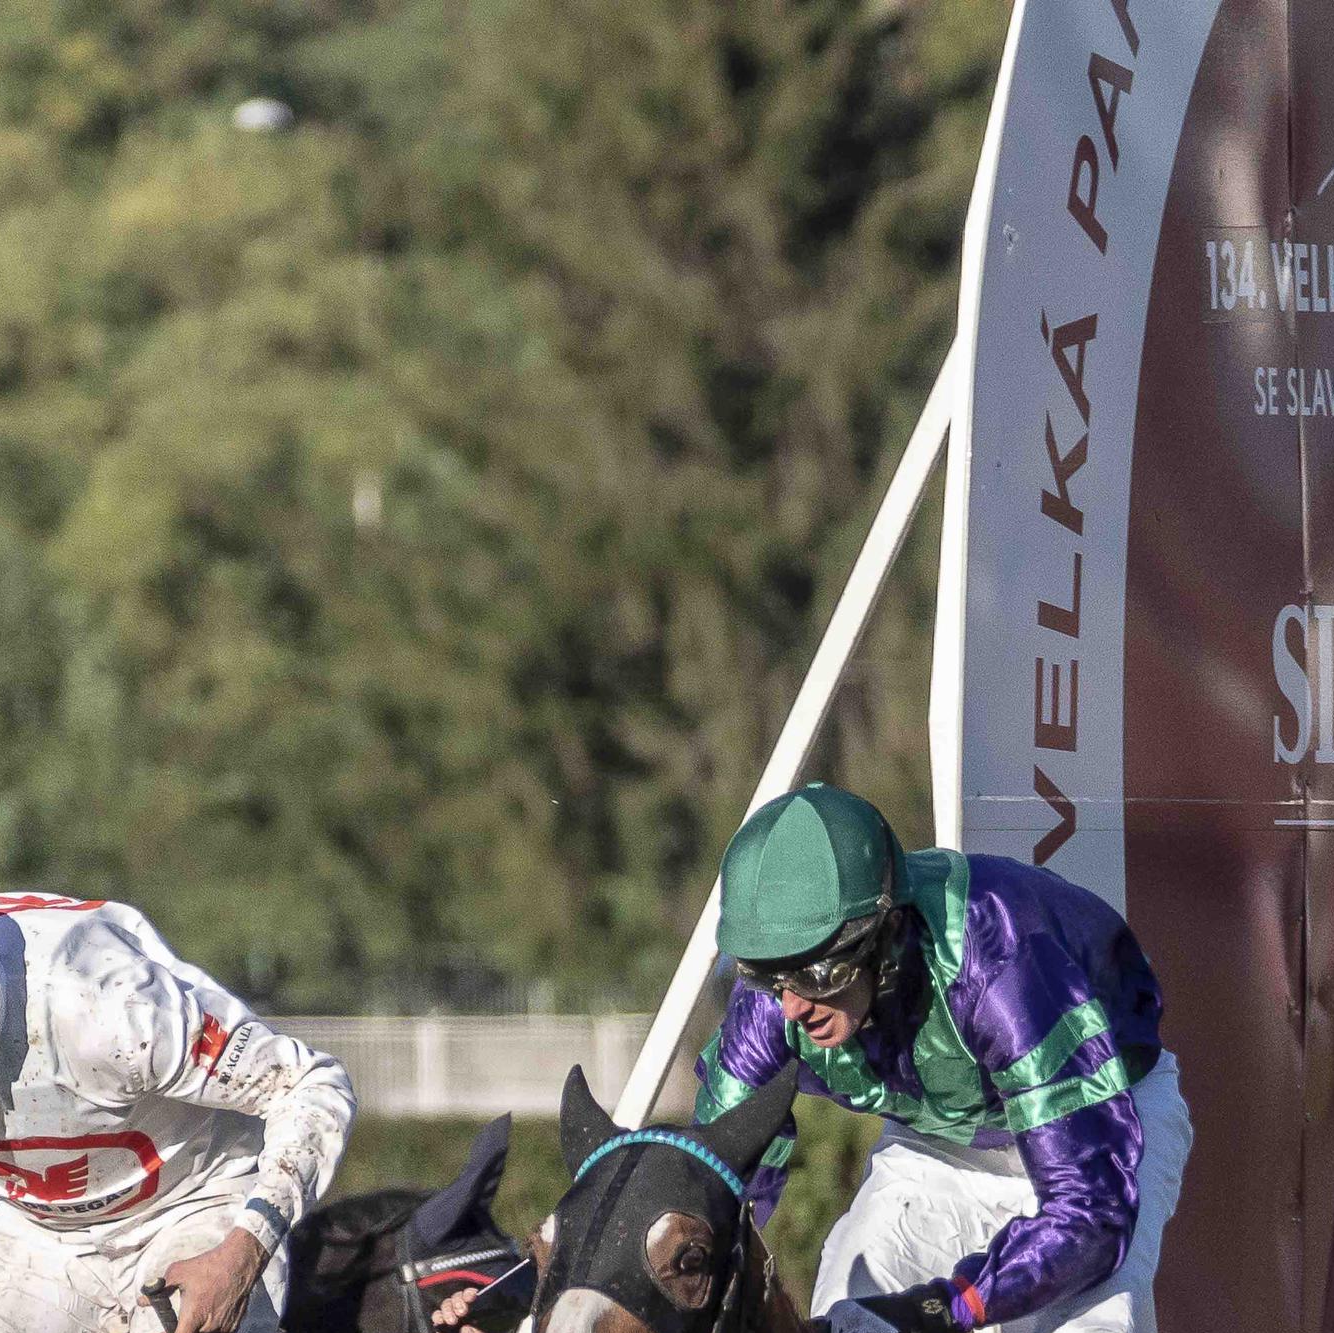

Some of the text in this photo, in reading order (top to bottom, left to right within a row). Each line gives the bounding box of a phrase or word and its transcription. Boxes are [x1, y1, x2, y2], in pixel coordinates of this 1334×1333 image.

[1206, 240, 1268, 311] 134.
[1254, 367, 1279, 416] SE
[1033, 308, 1100, 866] VELKÁ
